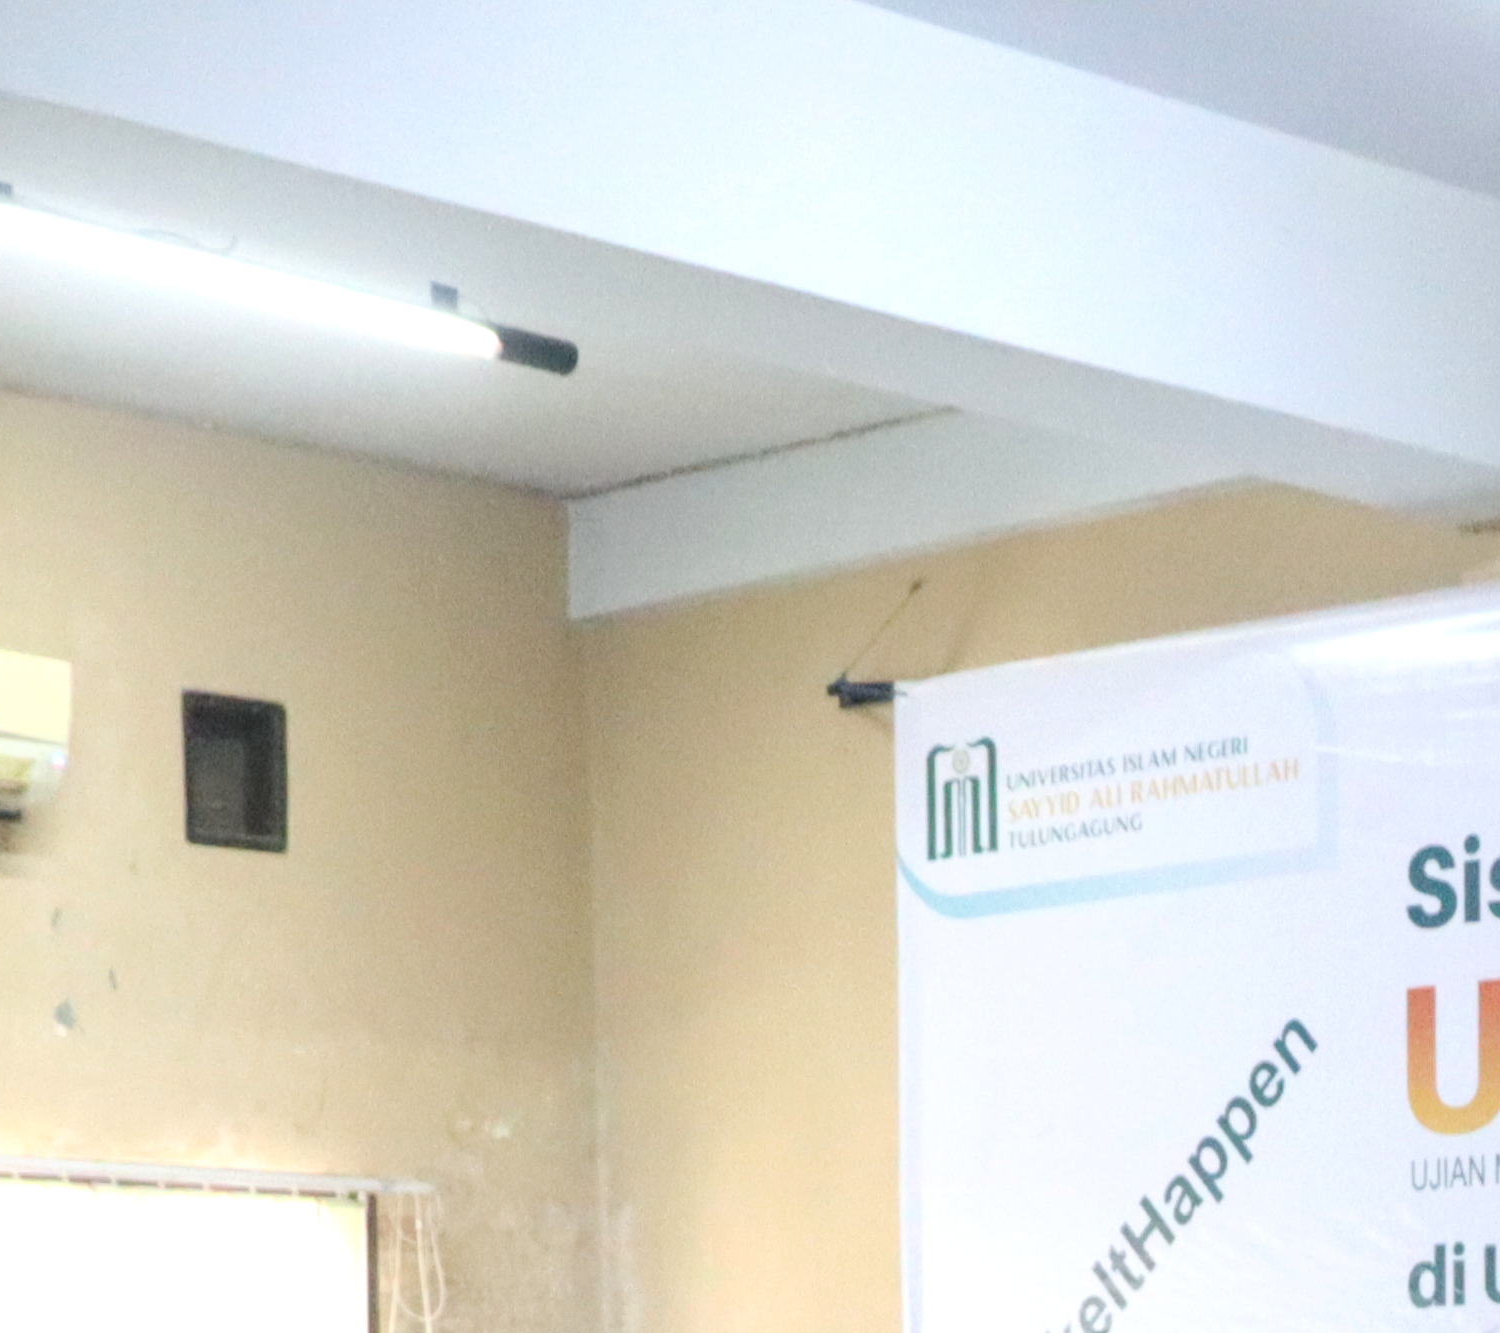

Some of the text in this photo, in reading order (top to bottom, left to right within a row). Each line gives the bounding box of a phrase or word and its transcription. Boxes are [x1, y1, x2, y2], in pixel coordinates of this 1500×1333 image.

[1007, 736, 1250, 791] UNIVERSITAS ISLAM NEGERI
[1007, 758, 1300, 823] SAYYID ALI RAHMATULLAH
[1008, 813, 1143, 849] TULUNGAGUNG
[1410, 1155, 1487, 1191] UJIAN
[1407, 1241, 1466, 1308] di
